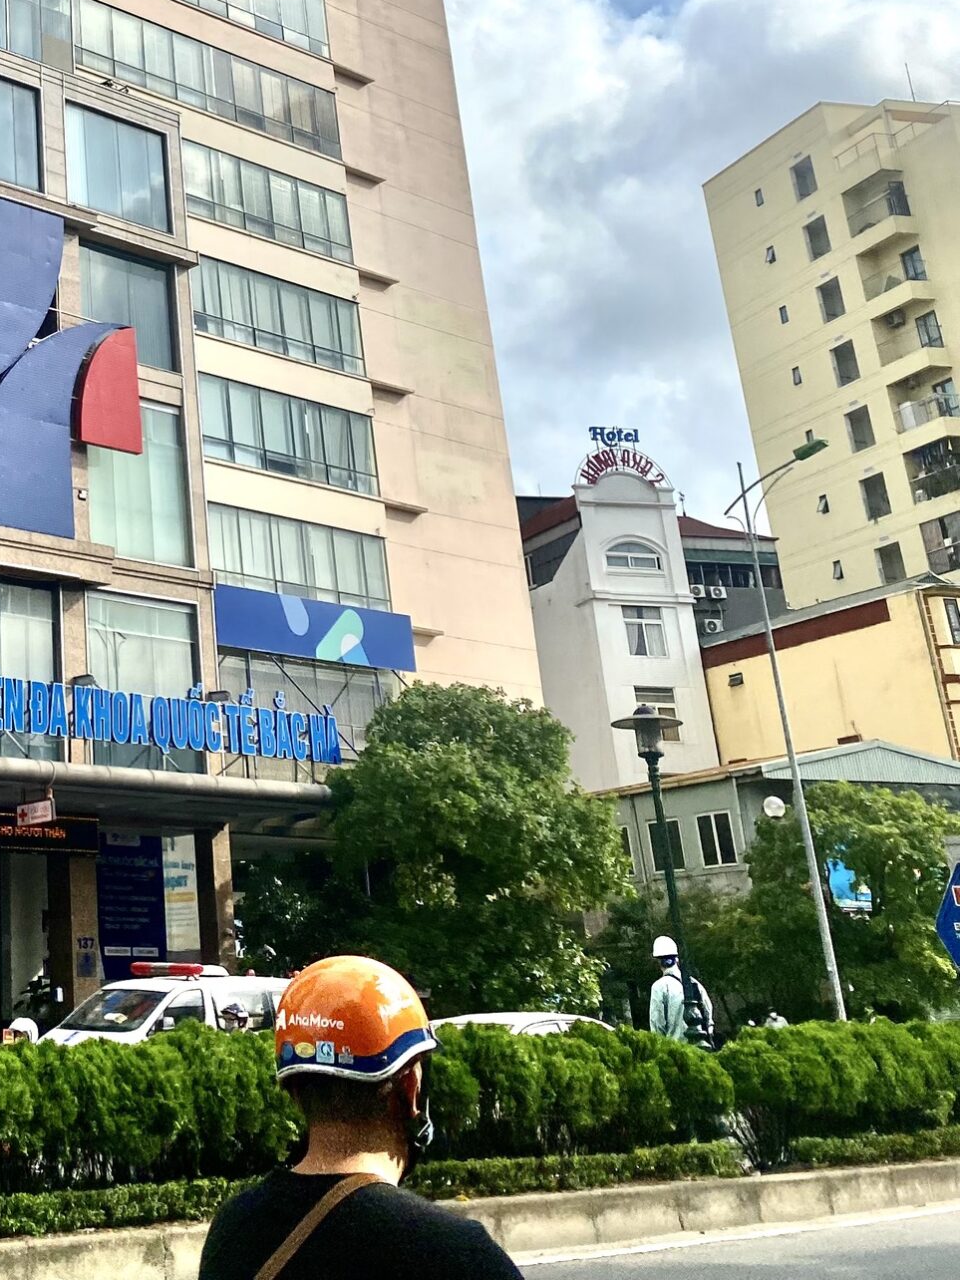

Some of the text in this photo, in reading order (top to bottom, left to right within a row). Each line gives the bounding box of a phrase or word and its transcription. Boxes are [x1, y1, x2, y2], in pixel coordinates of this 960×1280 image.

[588, 426, 640, 447] Hotel
[620, 449, 654, 477] ASIA
[648, 473, 665, 489] 2
[29, 680, 69, 737] ĐA
[73, 684, 149, 745] KHOA
[150, 682, 223, 755] QUỐC
[224, 688, 257, 756] TẾ
[257, 691, 308, 761] BẮC
[309, 704, 343, 764] HÀ
[77, 937, 94, 949] 137
[288, 1013, 345, 1031] AhaMove
